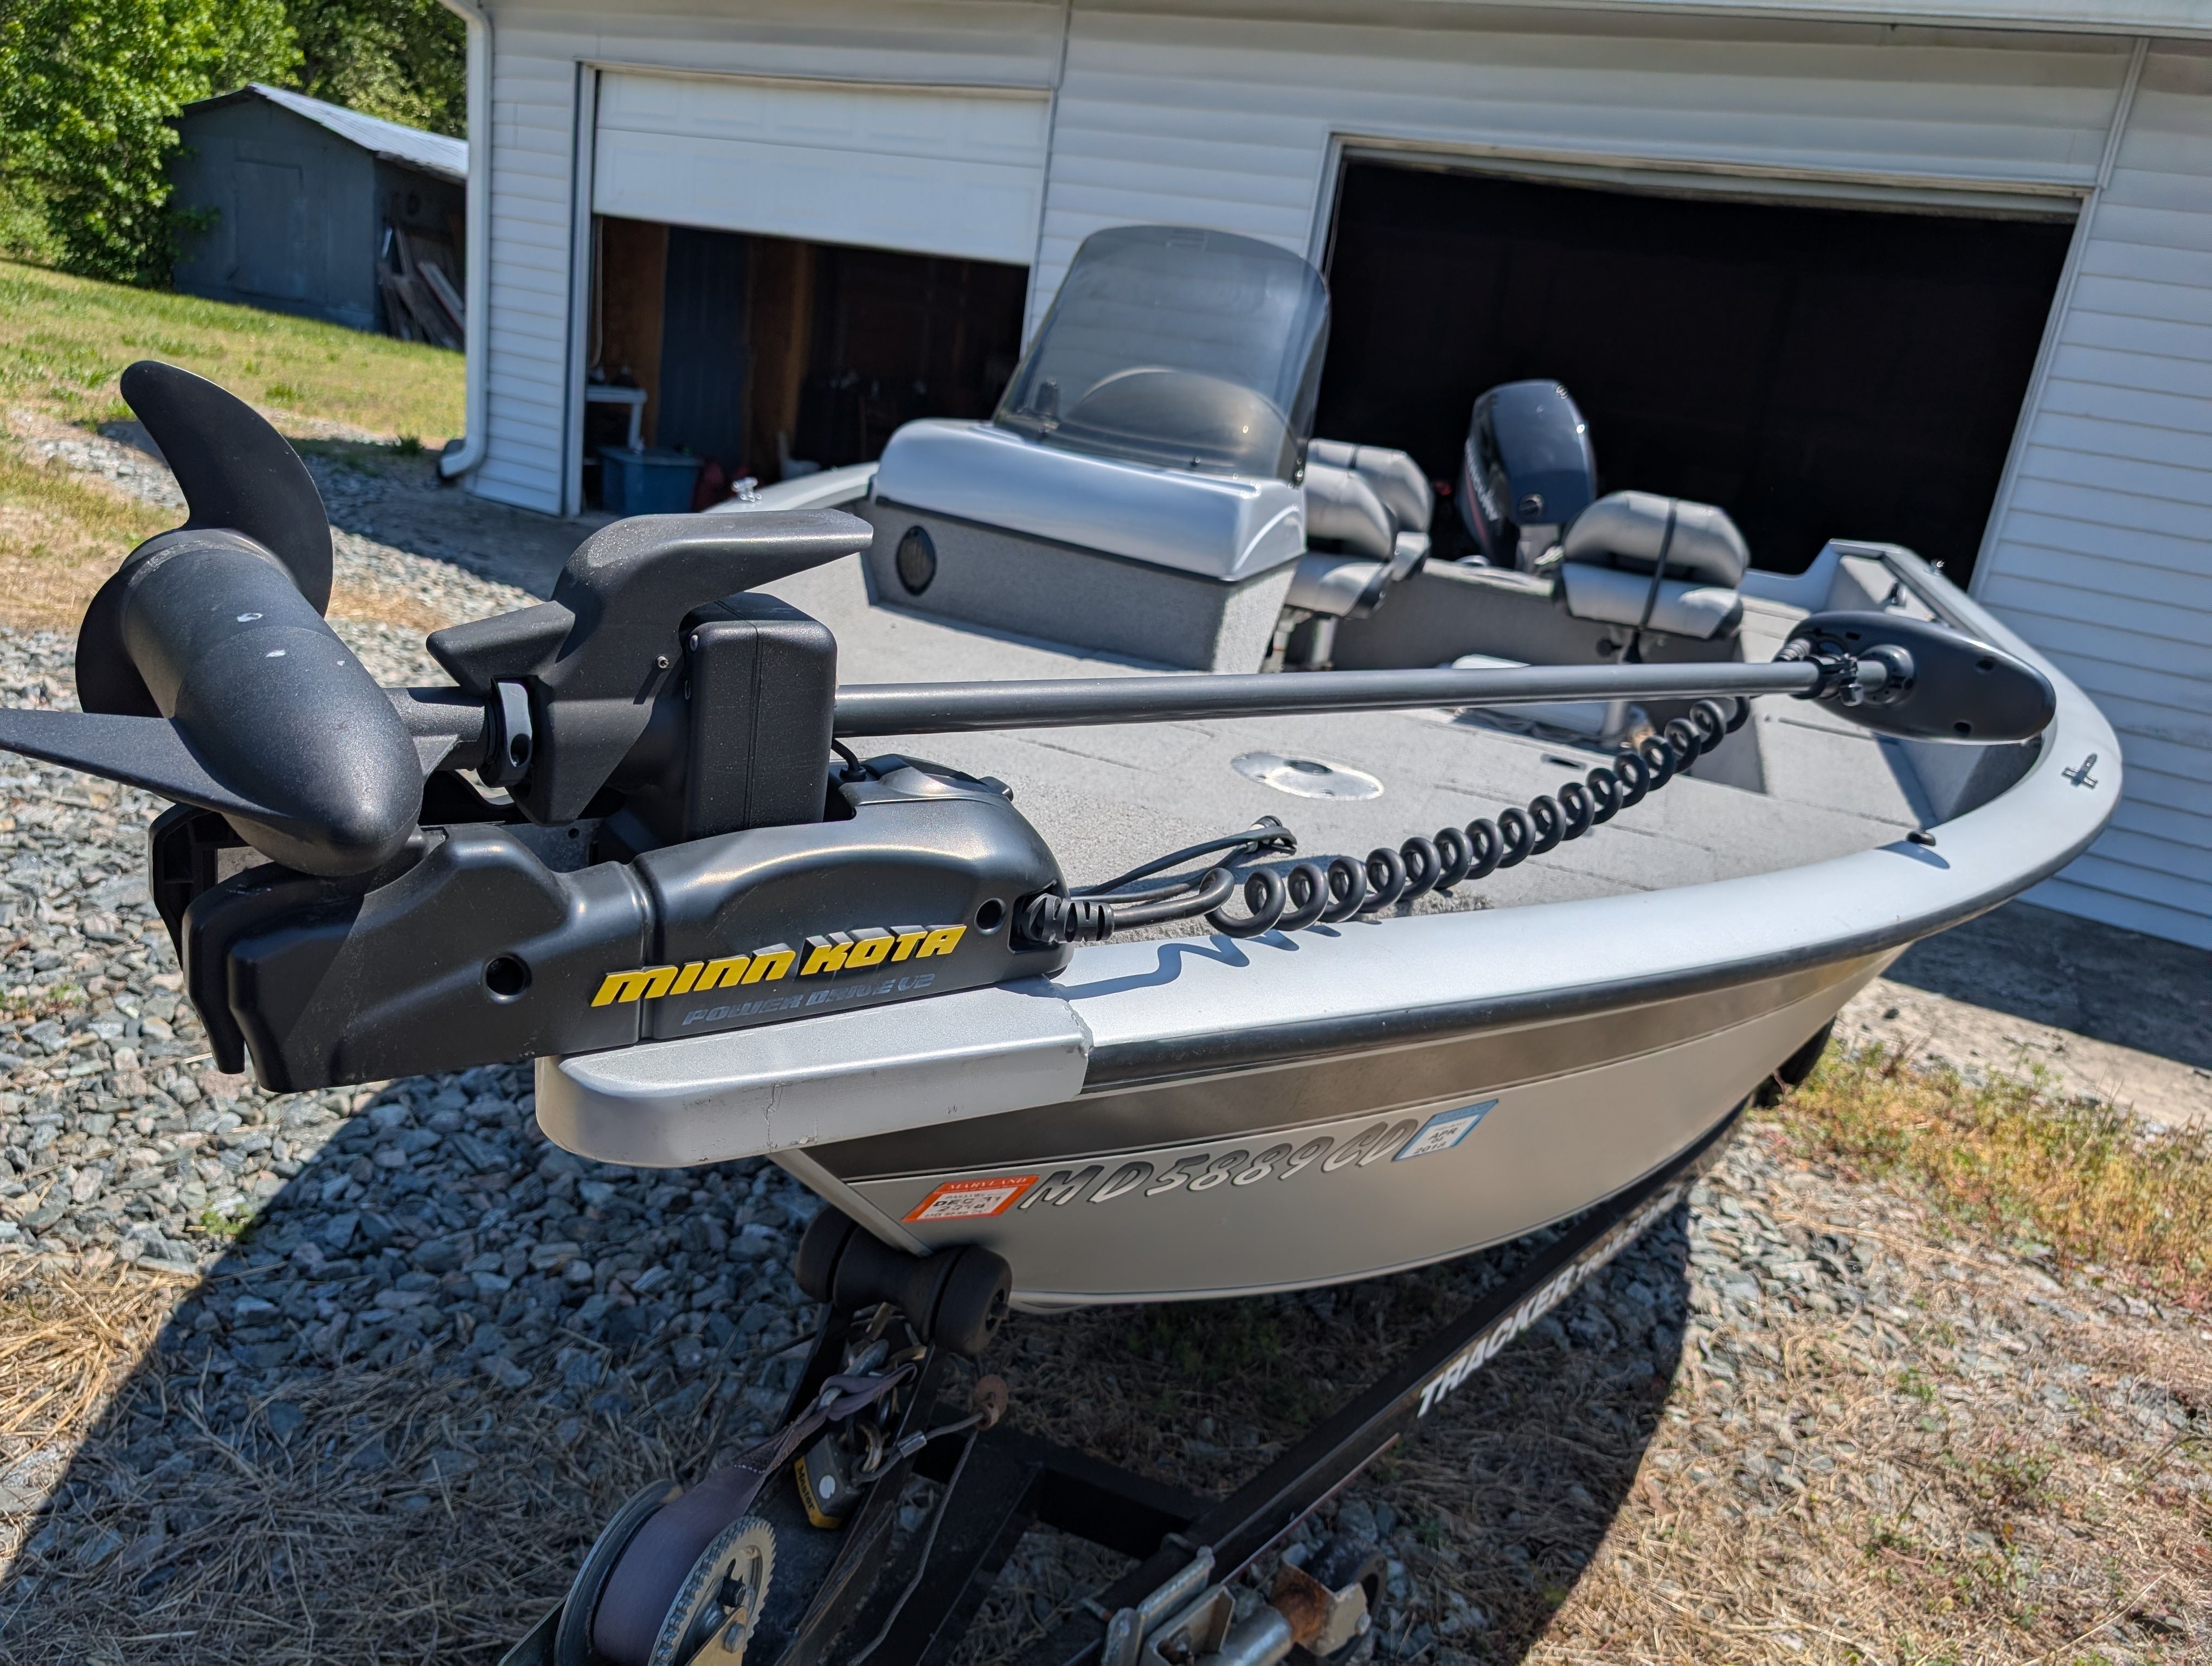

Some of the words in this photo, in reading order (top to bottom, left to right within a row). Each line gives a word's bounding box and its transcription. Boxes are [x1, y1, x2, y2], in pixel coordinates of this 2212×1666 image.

[591, 947, 796, 1007] MINN
[800, 924, 967, 976] KOTA
[681, 994, 803, 1026] POWER
[1428, 1127, 1458, 1140] APR
[933, 1197, 975, 1207] DEC
[1417, 1264, 1577, 1418] TRACKER
[798, 1465, 815, 1510] Master
